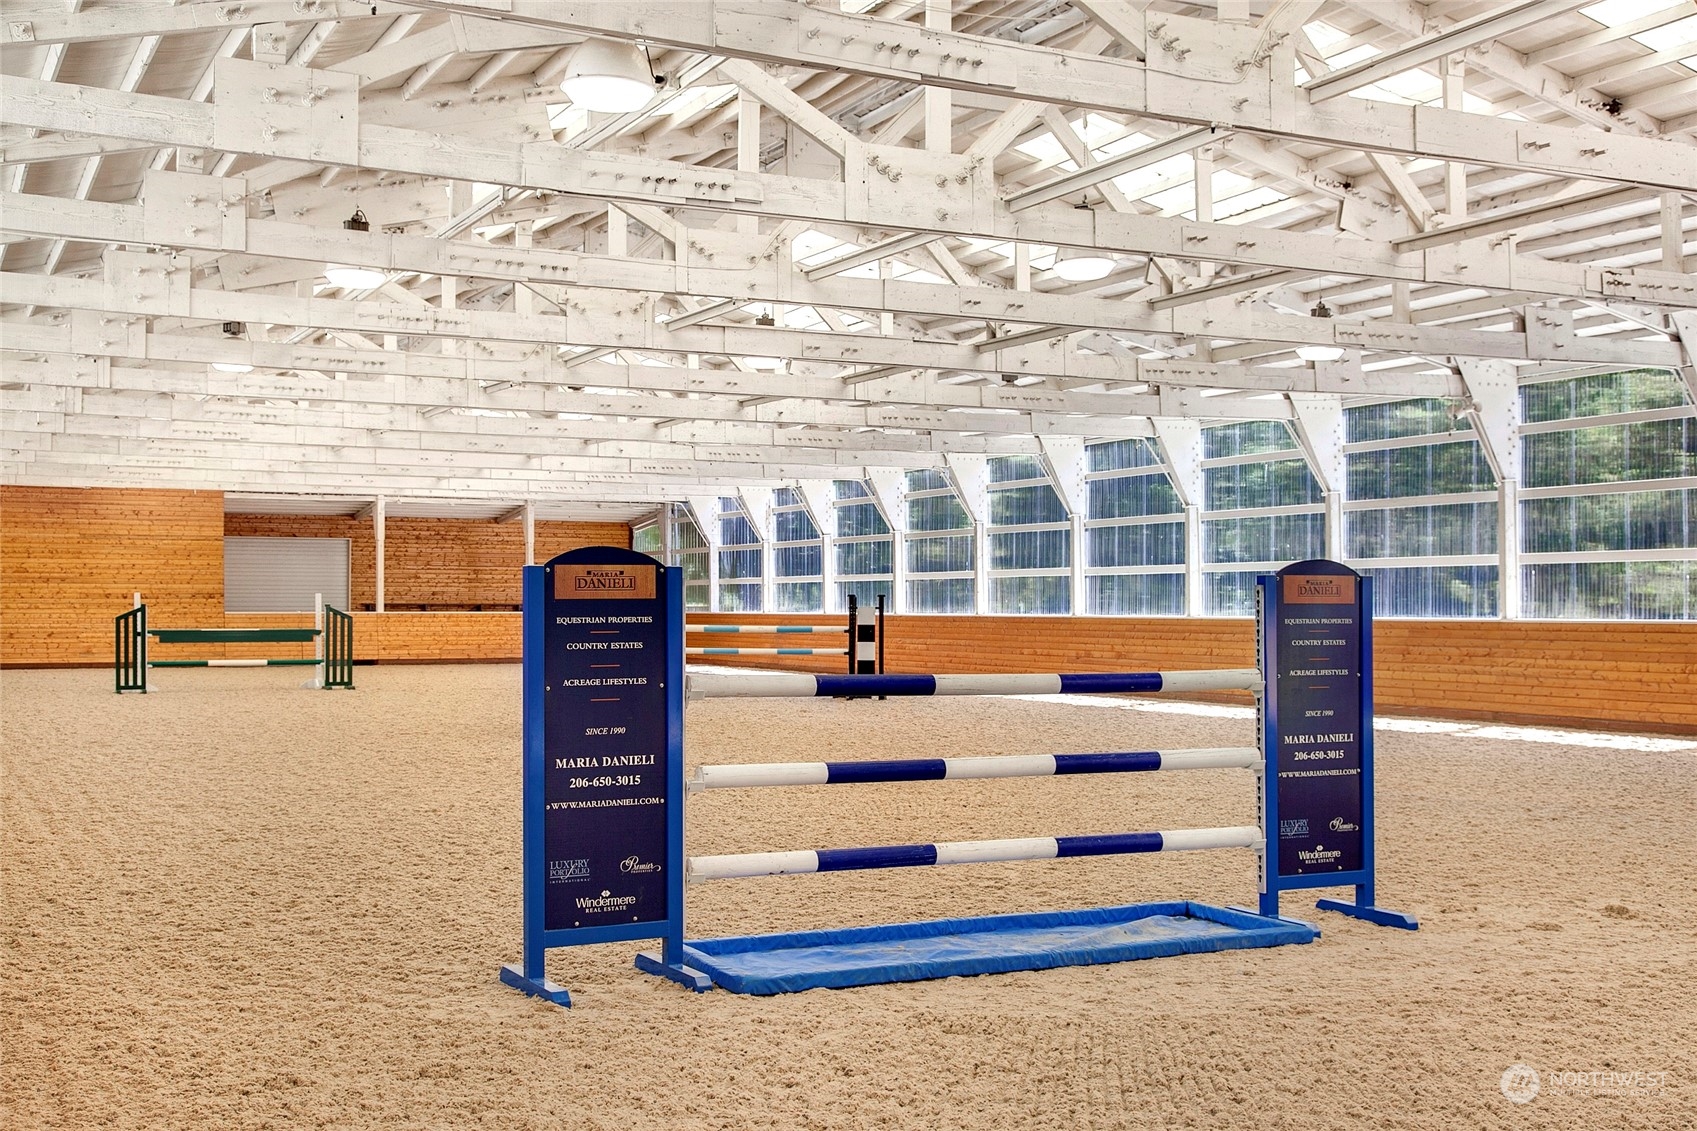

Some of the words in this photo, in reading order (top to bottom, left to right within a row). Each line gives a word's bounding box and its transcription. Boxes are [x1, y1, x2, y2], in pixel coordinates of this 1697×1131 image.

[577, 578, 634, 589] DANIELI
[1300, 586, 1339, 595] DANIELI
[556, 617, 606, 625] EQUESTRIAN
[608, 616, 653, 624] PROPERTIES
[585, 728, 608, 736] SINCE
[1284, 735, 1315, 744] MARIA
[1317, 733, 1354, 742] DANIELI
[1294, 750, 1344, 760] 206-650-3015
[555, 757, 599, 769] MARIA
[602, 754, 655, 767] DANIELI
[570, 775, 641, 788] 206-650-3015
[551, 797, 659, 810] WWW.MARIADANIELI.COM
[1280, 819, 1308, 828] LUXURY
[1298, 850, 1341, 860] Windermere
[550, 859, 589, 870] LUXURY
[620, 856, 661, 872] Premier
[550, 866, 590, 878] PORTFOLIO
[576, 896, 636, 909] Windermere
